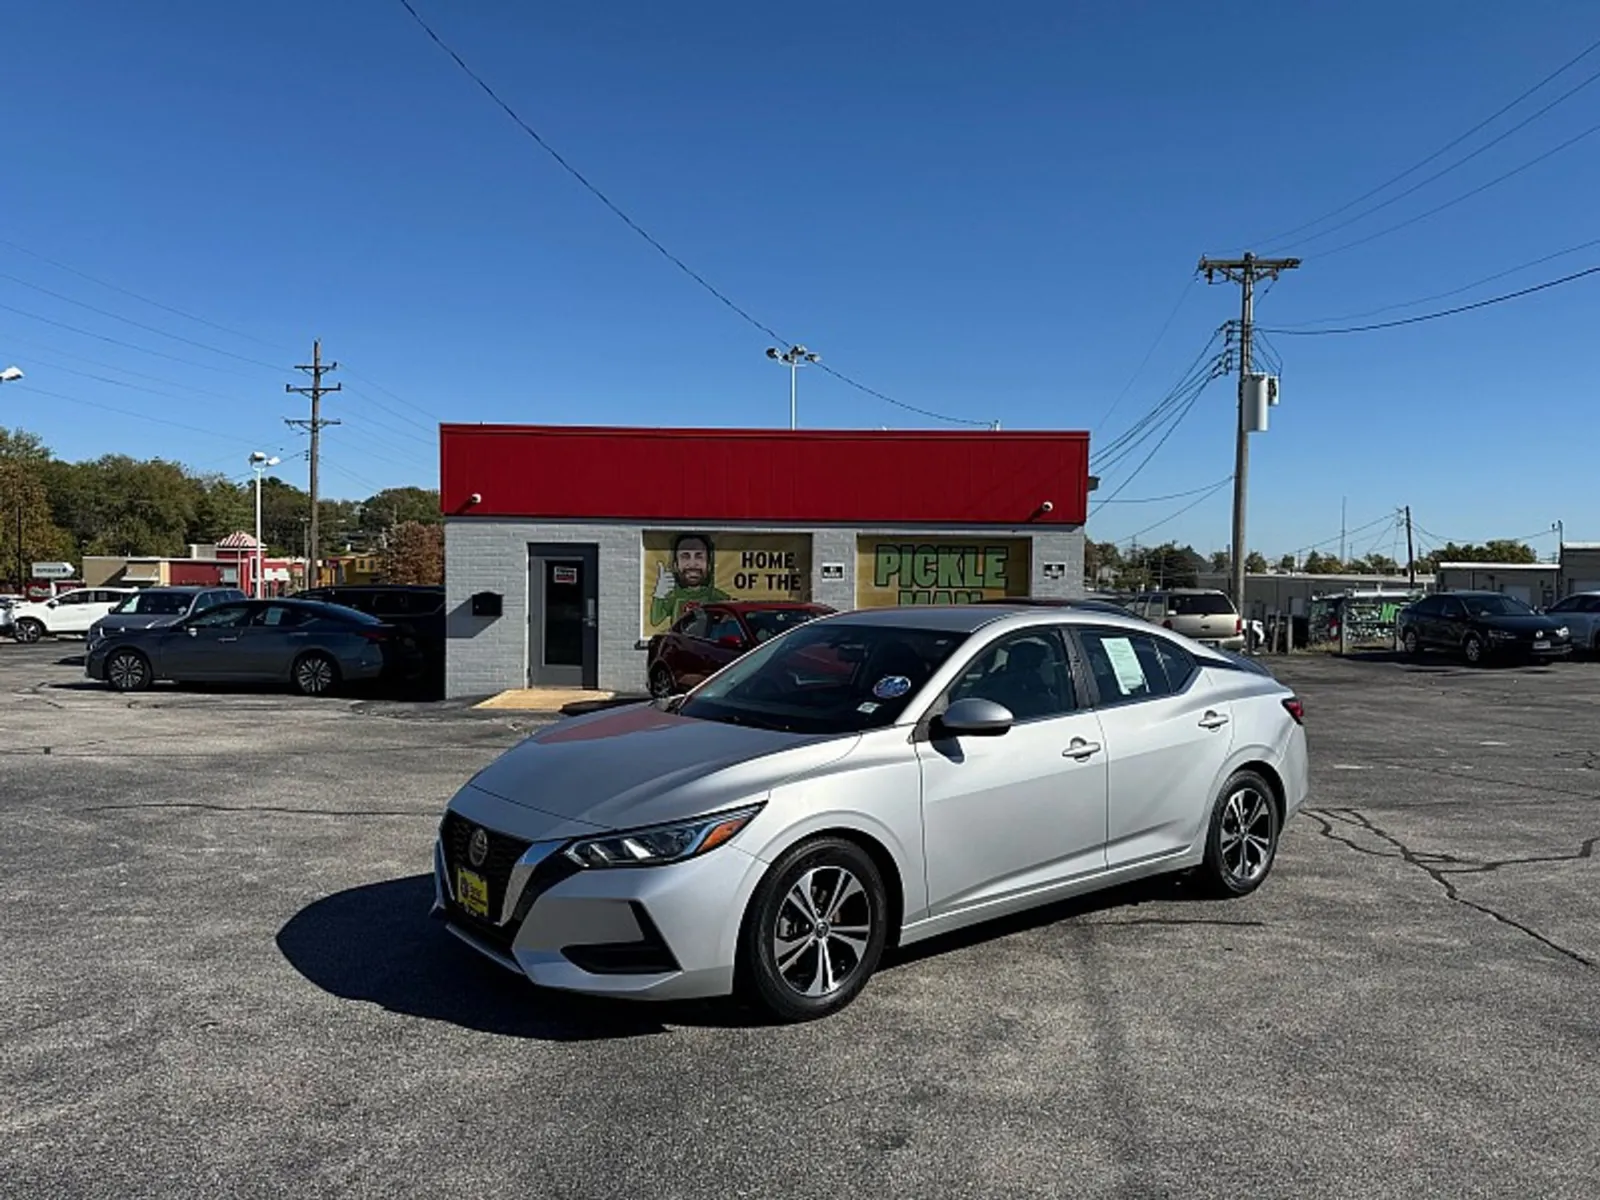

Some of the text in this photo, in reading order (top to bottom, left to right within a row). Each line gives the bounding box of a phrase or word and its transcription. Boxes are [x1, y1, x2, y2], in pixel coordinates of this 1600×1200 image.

[742, 552, 795, 569] HOME
[874, 544, 1009, 589] PICKLE
[734, 573, 801, 591] OF THE
